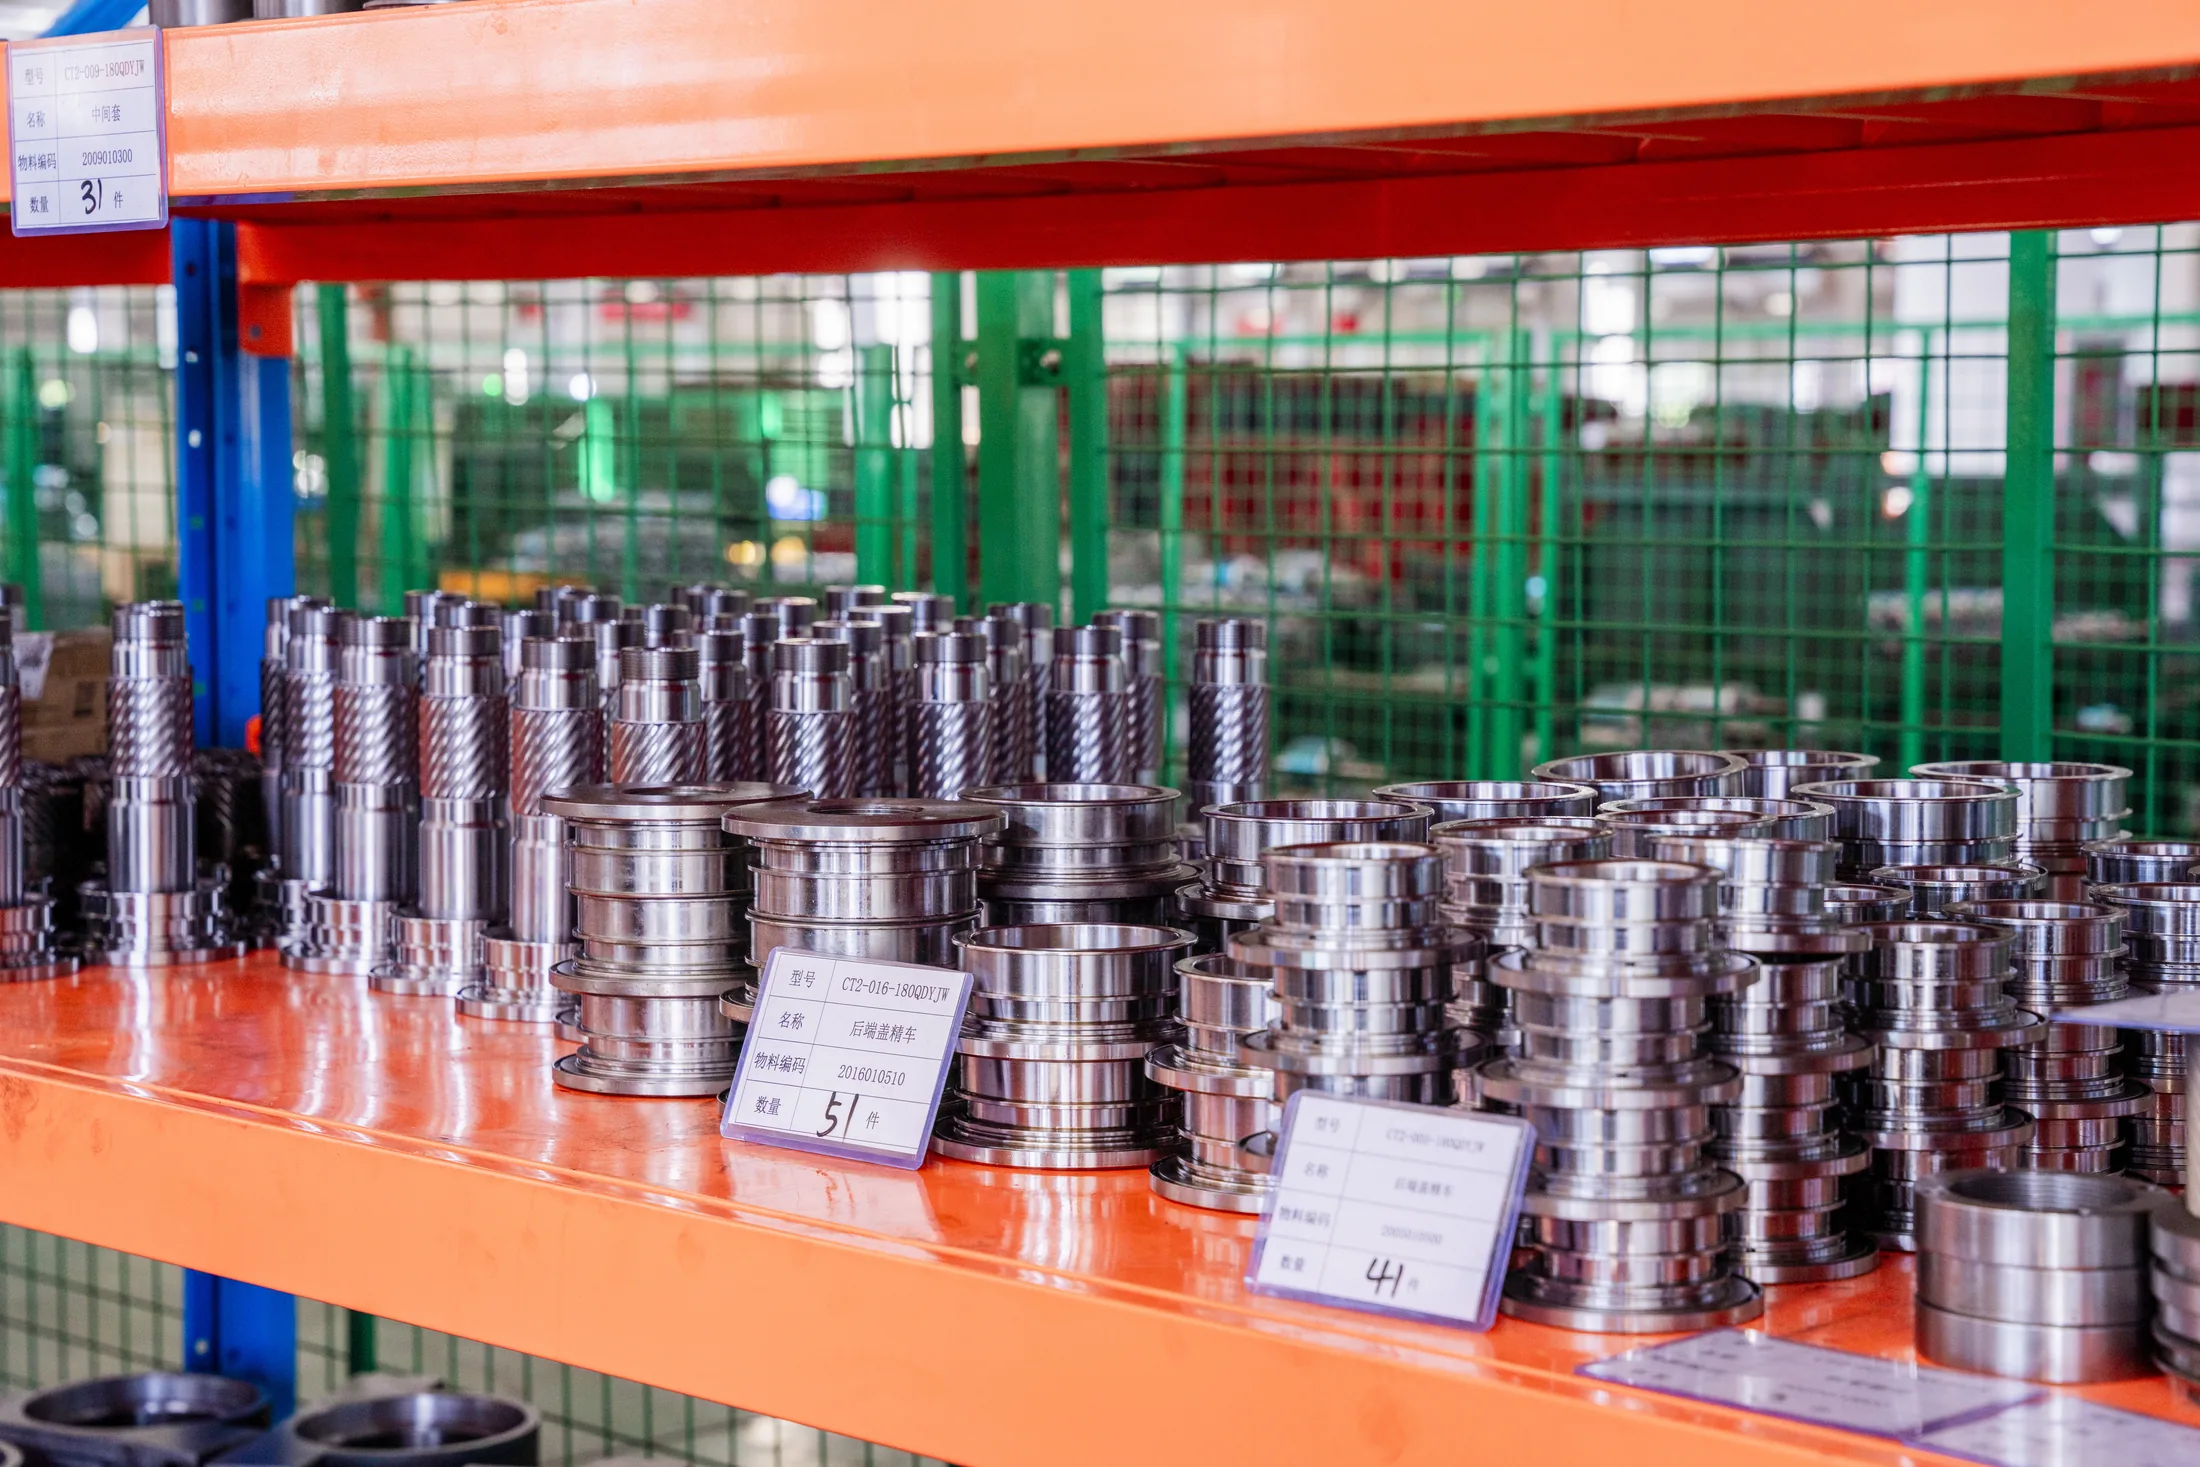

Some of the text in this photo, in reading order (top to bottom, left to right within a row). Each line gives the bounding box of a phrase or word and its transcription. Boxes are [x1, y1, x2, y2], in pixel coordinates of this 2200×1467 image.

[25, 68, 44, 85] 型号
[64, 60, 145, 81] CT2-009-180QDYJW
[26, 110, 45, 128] 名称
[92, 104, 121, 123] 中间套
[18, 152, 57, 171] 物料编码
[82, 149, 133, 166] 2009010300
[30, 196, 49, 213] 数量
[81, 178, 102, 215] 31
[114, 190, 123, 208] 件
[789, 969, 816, 988] 型号
[842, 977, 950, 1003] CT2-016-180QDYJW
[778, 1011, 805, 1029] 名称
[849, 1020, 917, 1044] 后端盖精车
[754, 1052, 806, 1074] 物料编码
[838, 1065, 905, 1086] 2016010510
[754, 1096, 781, 1116] 数量
[816, 1091, 859, 1143] 51
[866, 1111, 879, 1129] 件
[1366, 1257, 1403, 1298] 41
